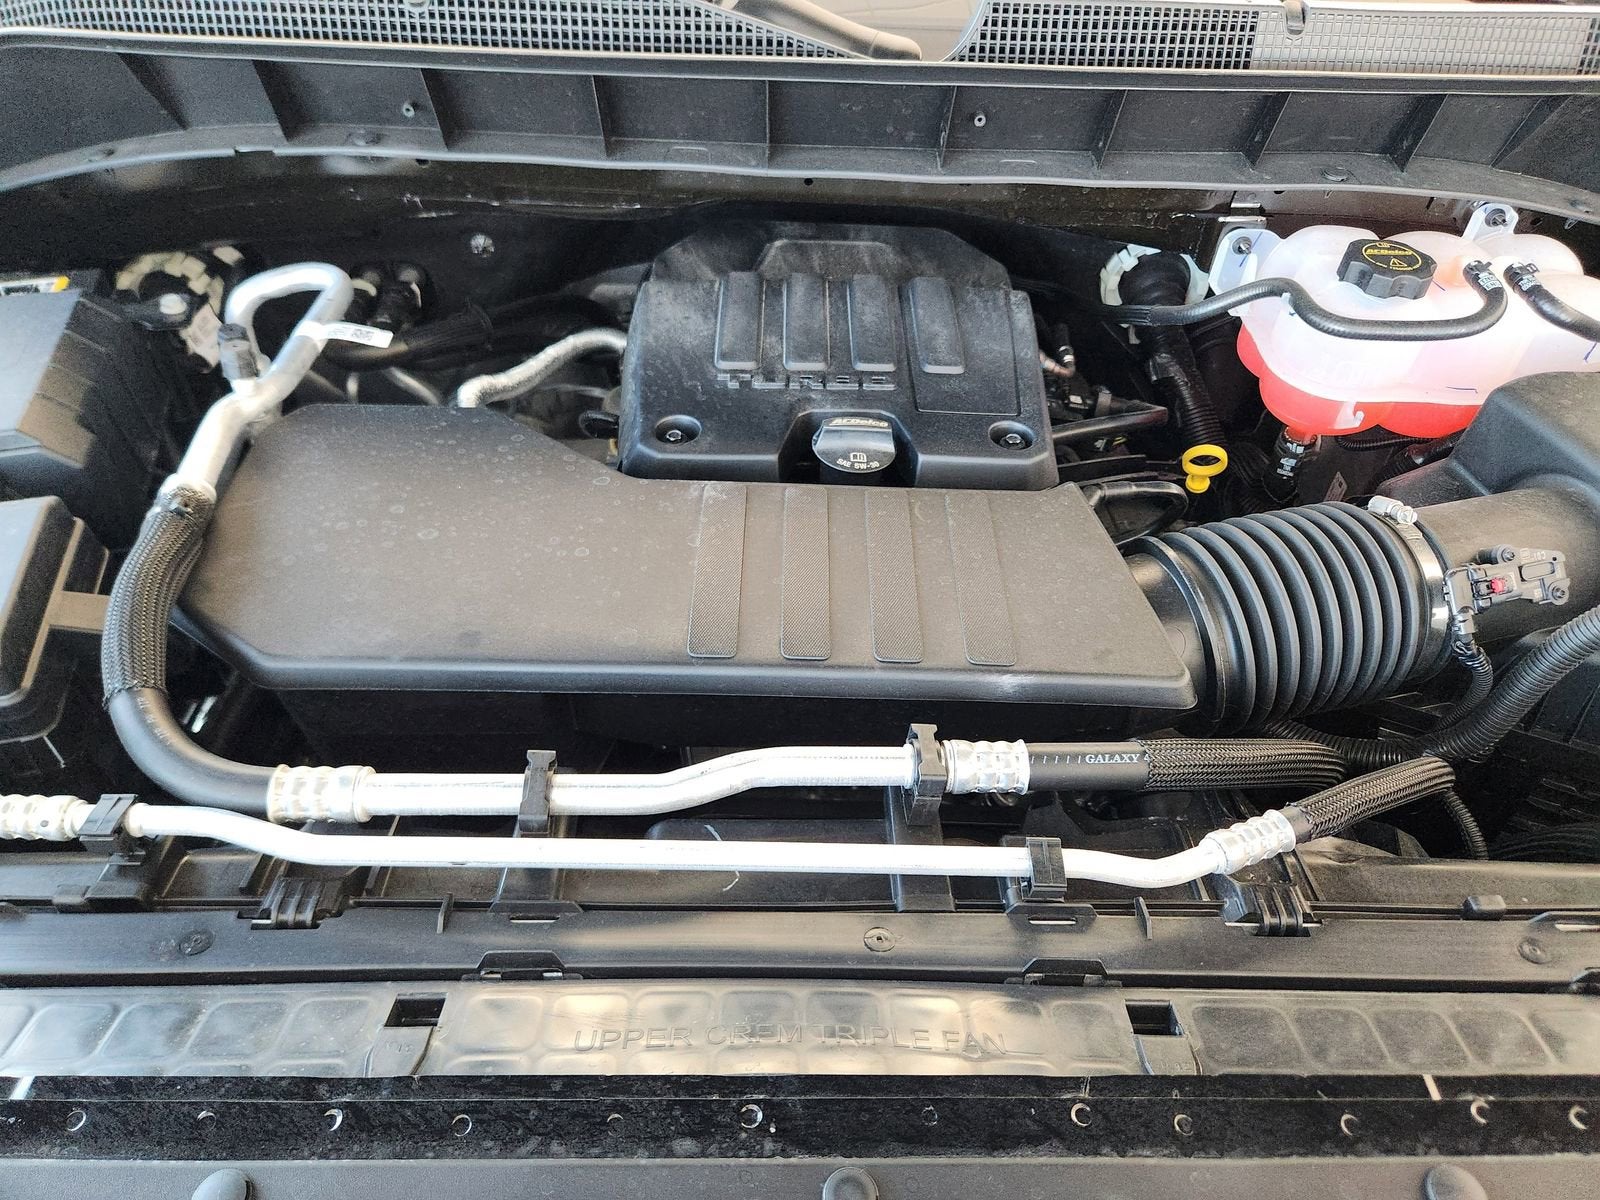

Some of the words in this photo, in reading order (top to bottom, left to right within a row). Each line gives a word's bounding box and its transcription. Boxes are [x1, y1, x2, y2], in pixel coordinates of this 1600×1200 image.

[829, 418, 888, 427] ACDelco
[836, 458, 852, 468] SAE
[853, 460, 880, 470] 5W-30
[1085, 753, 1140, 763] GALAXY
[574, 1026, 695, 1051] UPPER
[812, 1024, 933, 1050] TRIPLE
[942, 1029, 1008, 1057] FAN
